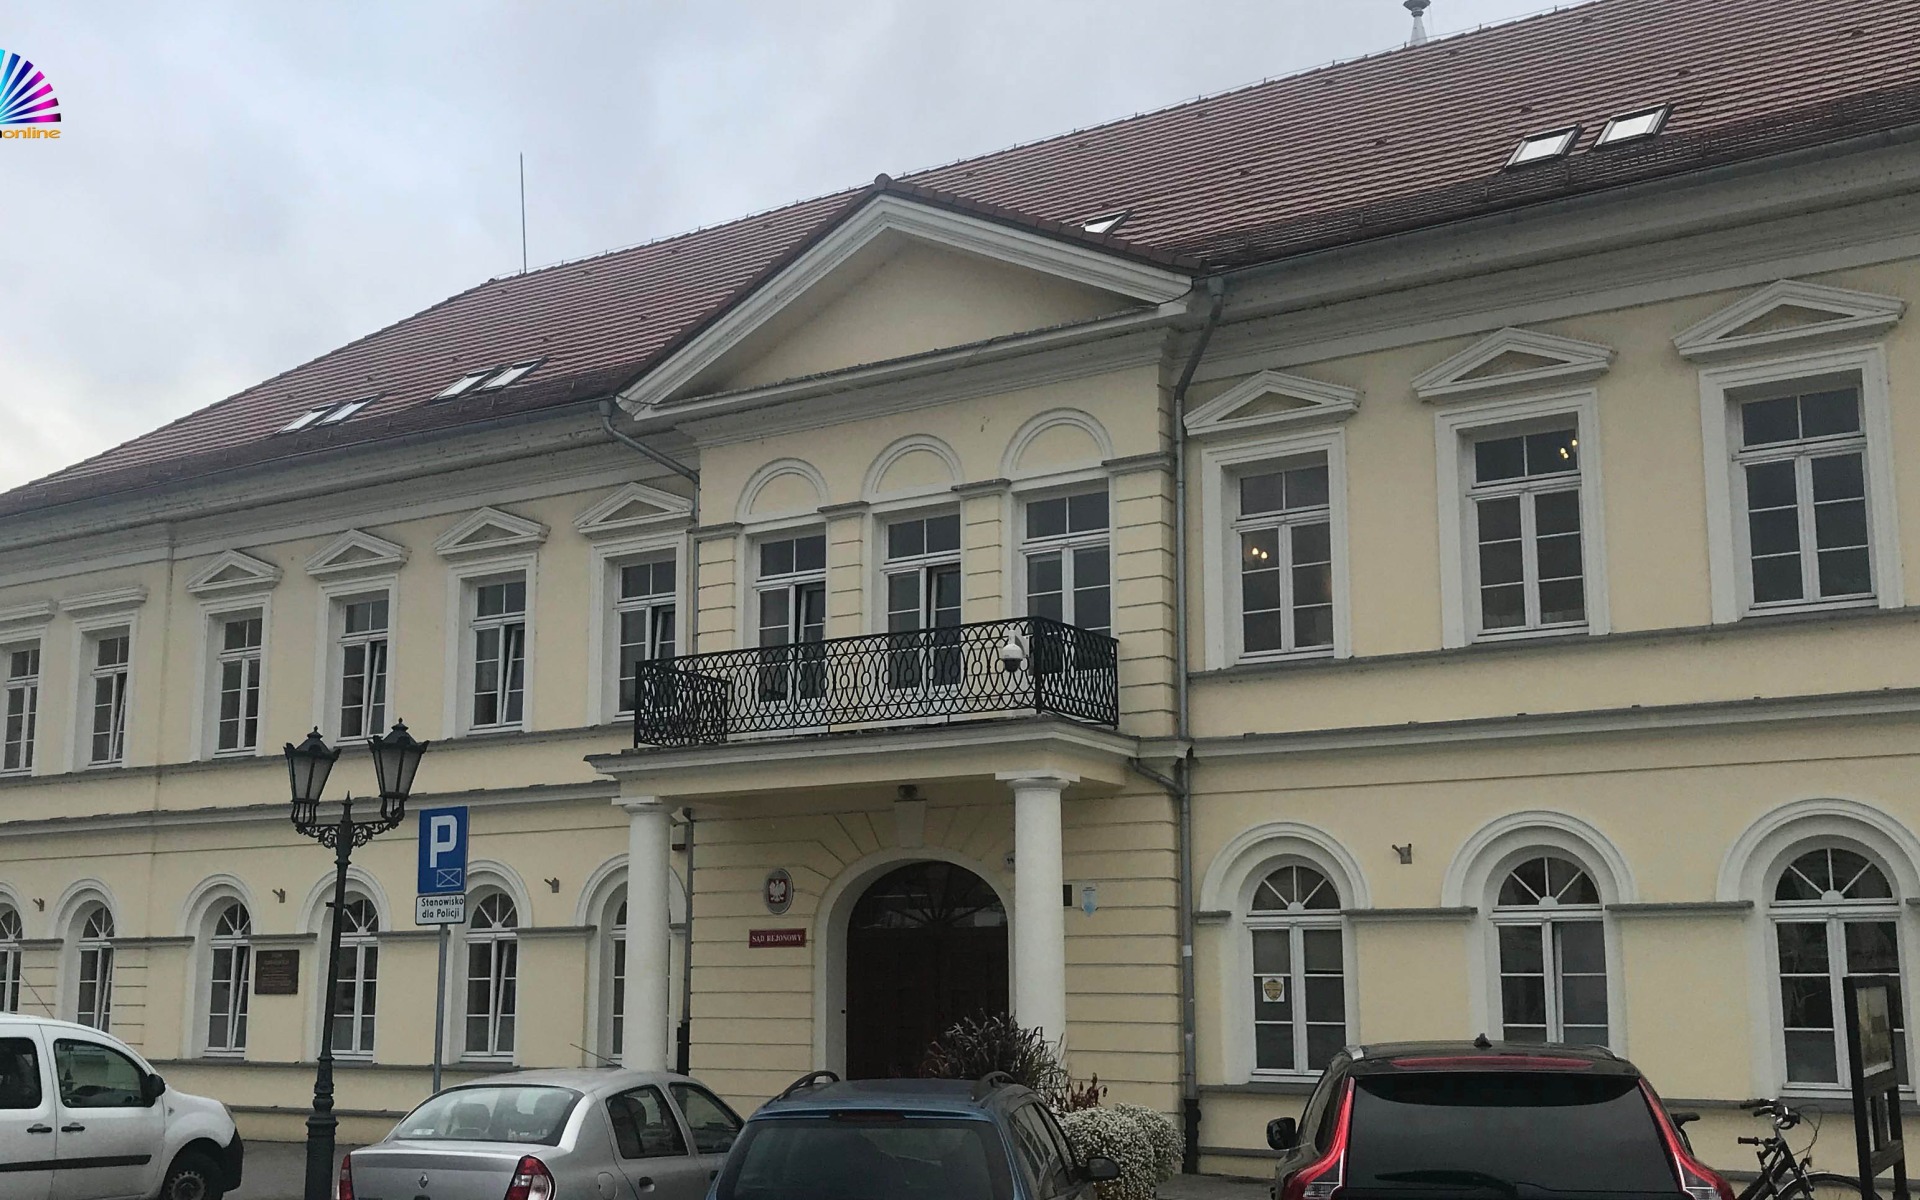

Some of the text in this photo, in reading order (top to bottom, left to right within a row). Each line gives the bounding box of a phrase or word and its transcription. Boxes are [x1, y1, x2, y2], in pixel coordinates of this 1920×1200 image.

[430, 815, 458, 868] P
[421, 896, 464, 907] Stanowisko
[422, 908, 460, 919] dla Policji
[752, 934, 802, 943] SĄD REJONOWY
